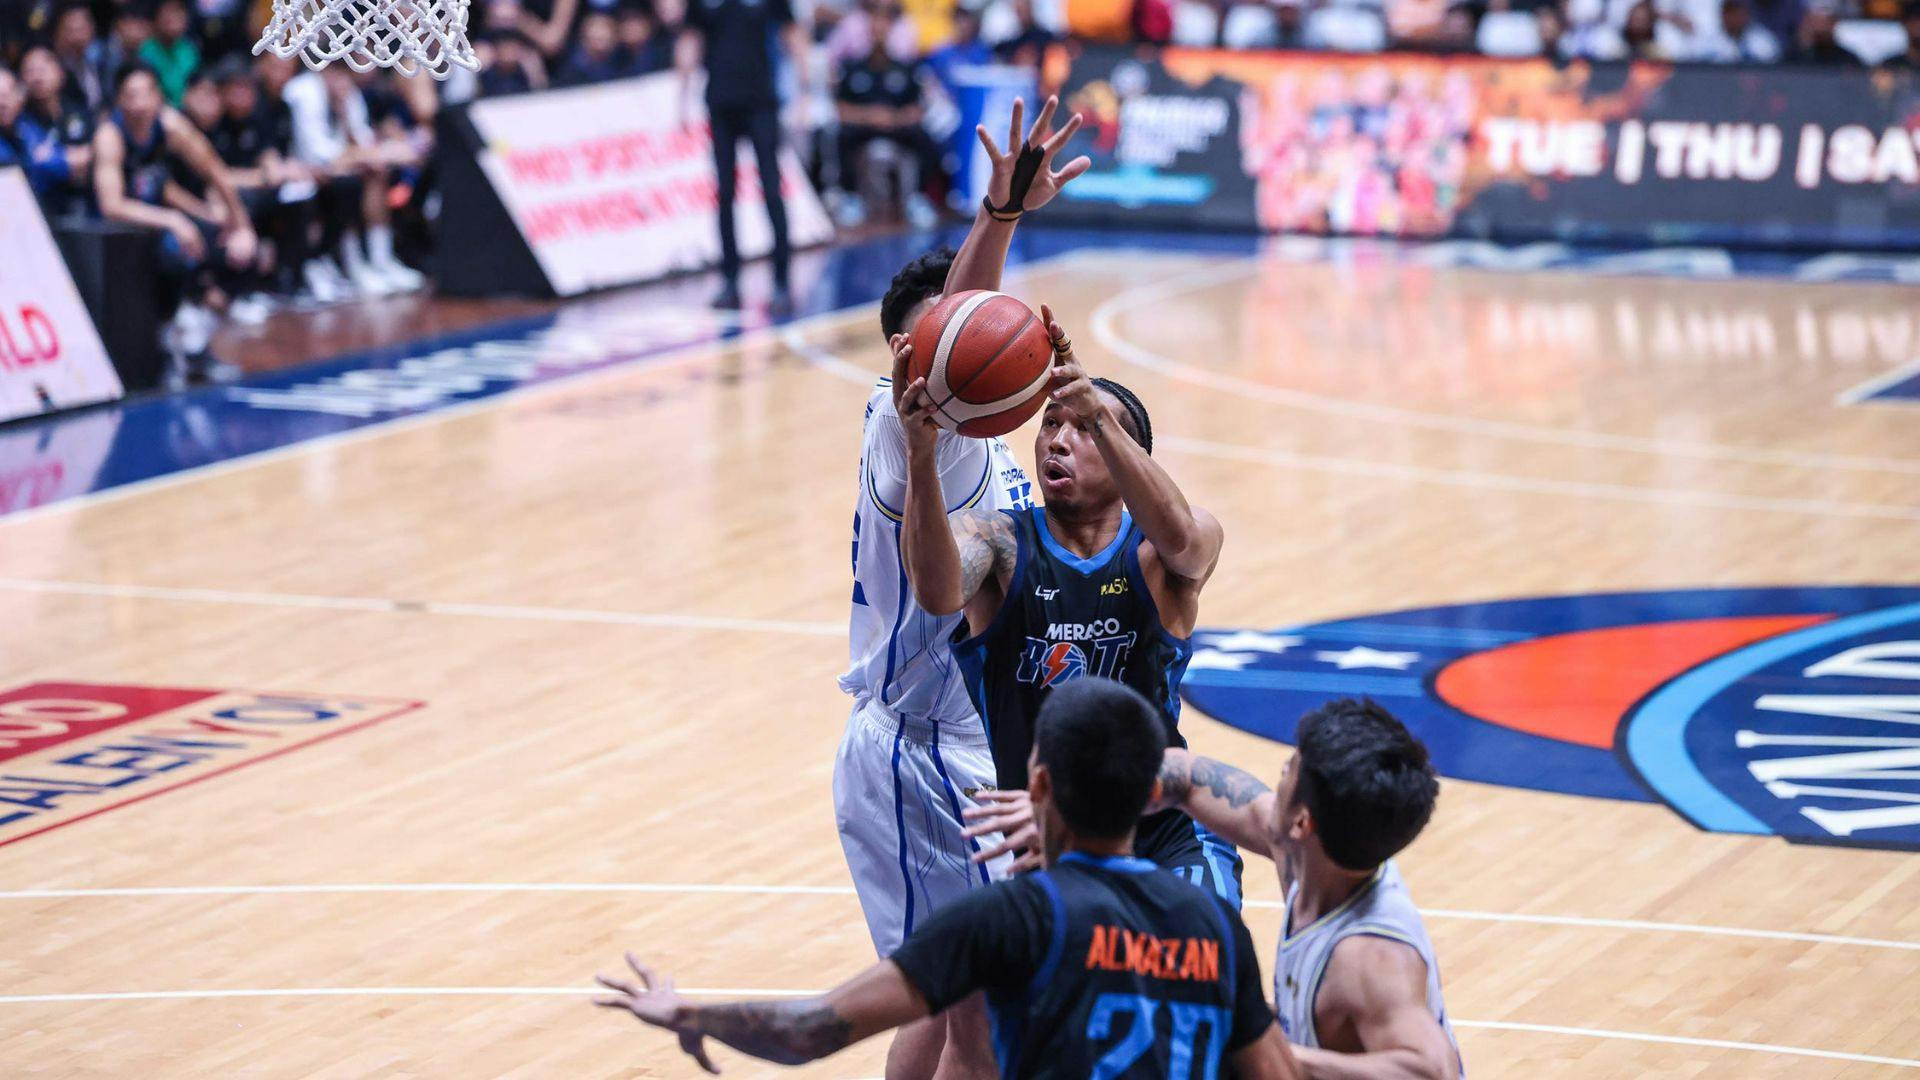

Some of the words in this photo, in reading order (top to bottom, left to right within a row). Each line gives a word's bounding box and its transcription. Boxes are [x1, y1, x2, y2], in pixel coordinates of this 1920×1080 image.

[1482, 115, 1607, 177] TUE
[1649, 121, 1782, 182] THU
[1827, 125, 1920, 184] SA
